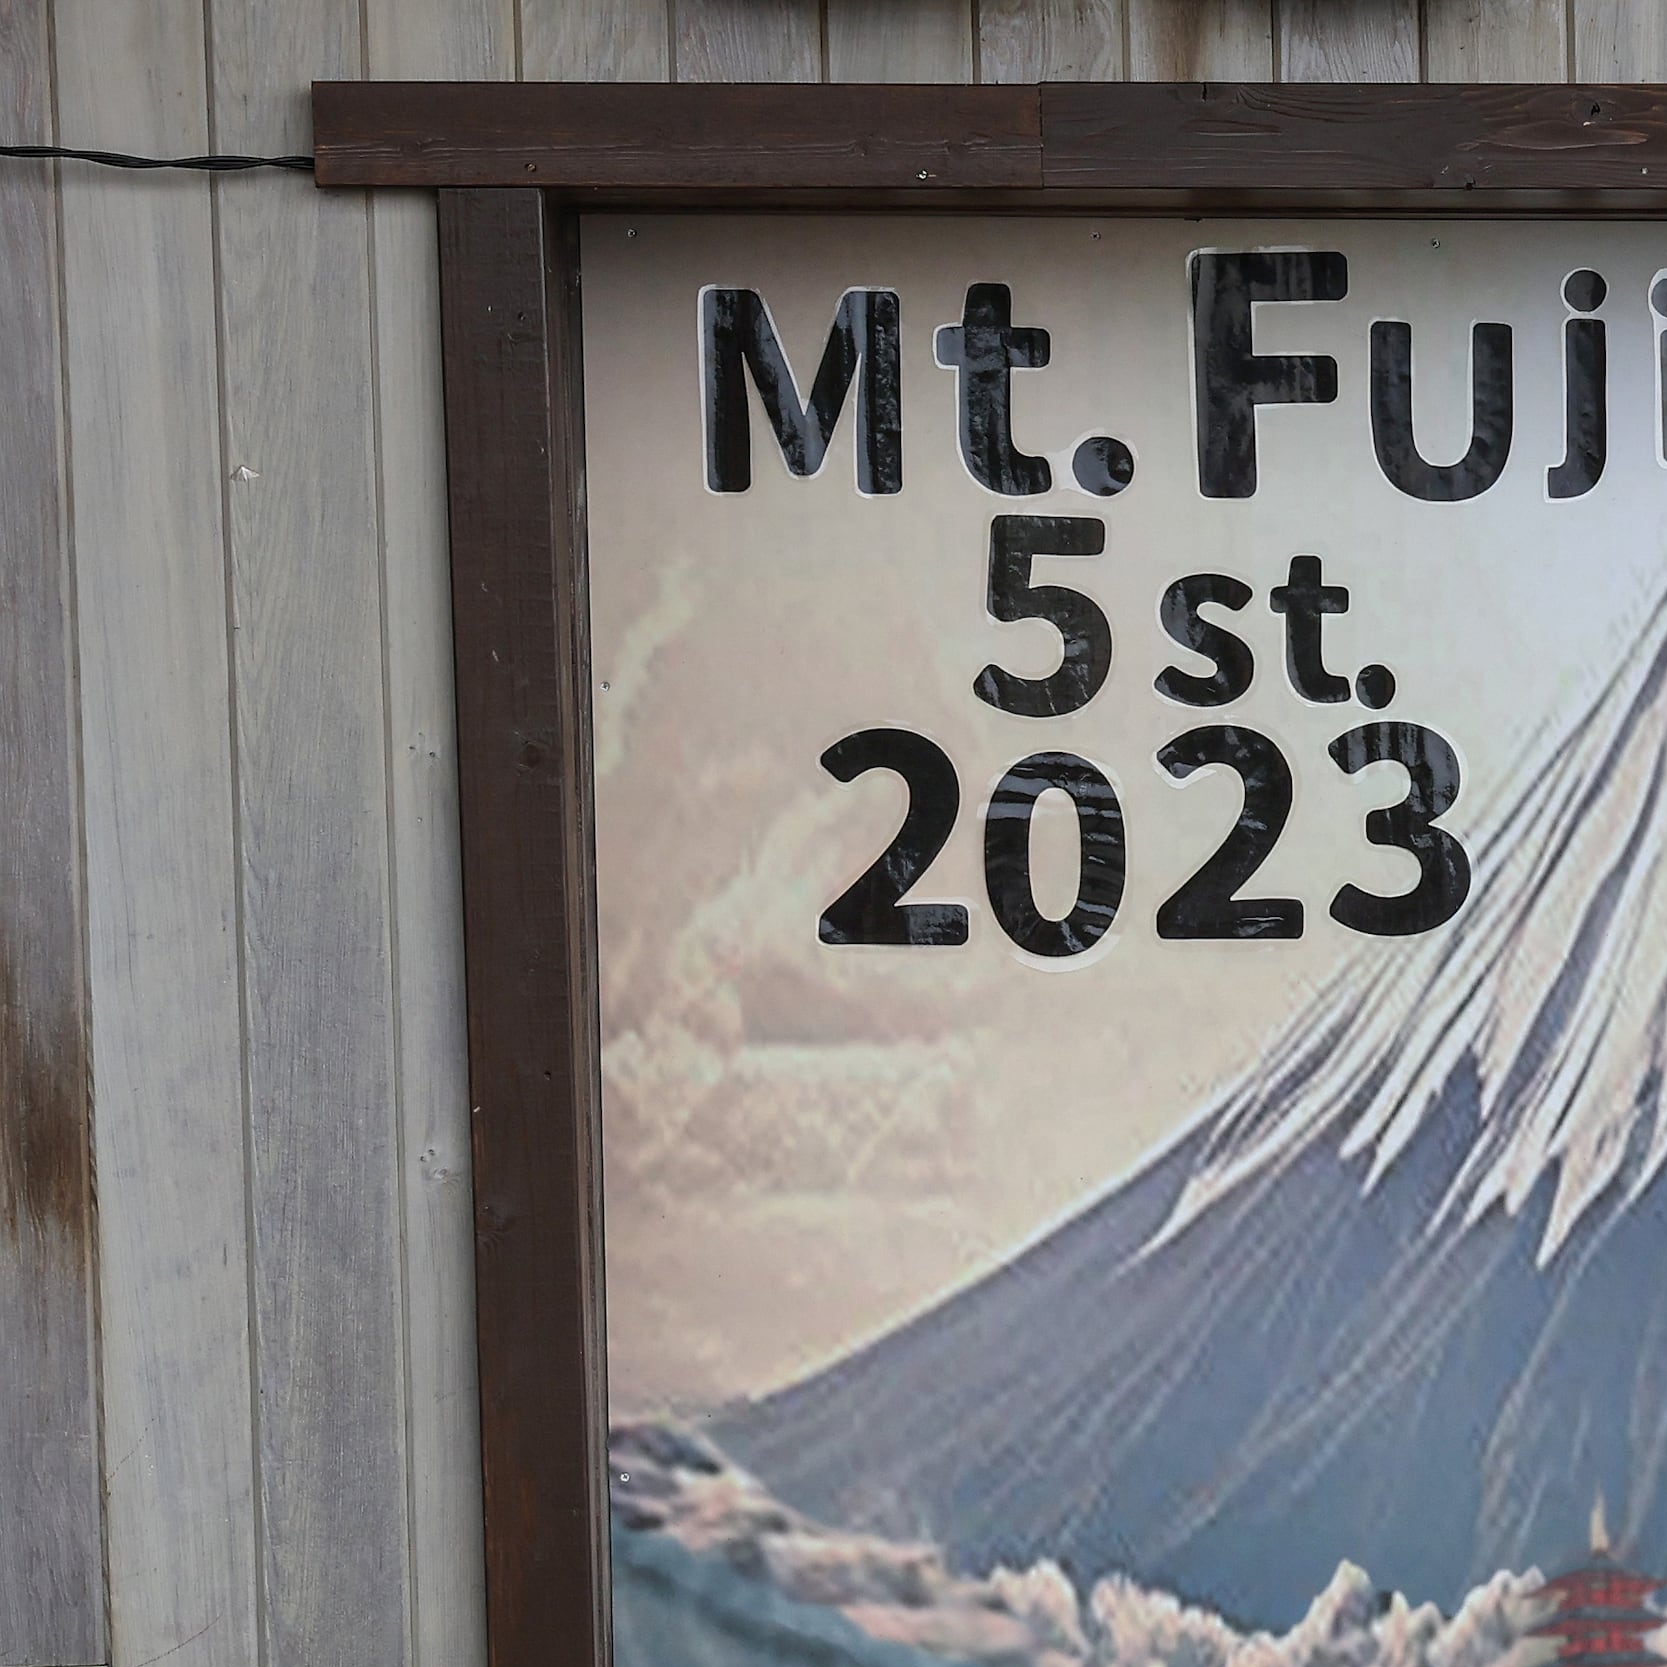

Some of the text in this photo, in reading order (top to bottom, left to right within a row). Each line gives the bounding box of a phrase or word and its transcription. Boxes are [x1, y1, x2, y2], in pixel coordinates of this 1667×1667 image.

[697, 281, 1136, 496] Mt.
[973, 515, 1397, 717] 5 st.
[817, 721, 1472, 957] 2023
